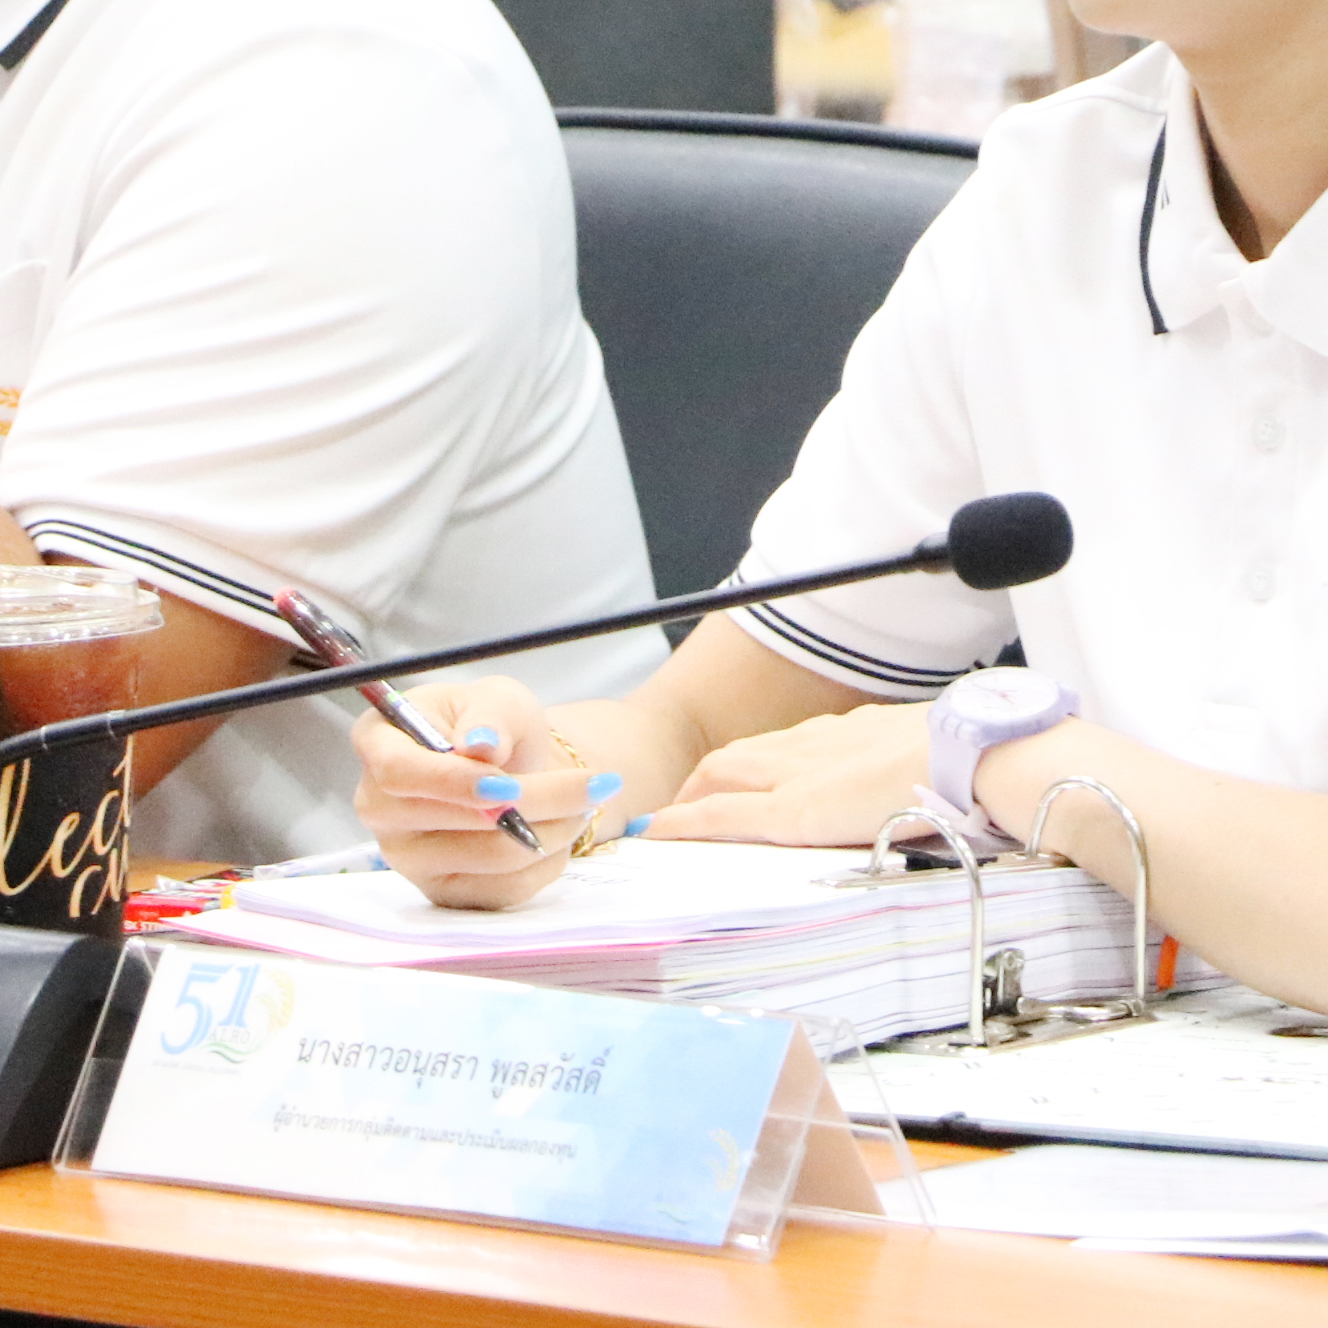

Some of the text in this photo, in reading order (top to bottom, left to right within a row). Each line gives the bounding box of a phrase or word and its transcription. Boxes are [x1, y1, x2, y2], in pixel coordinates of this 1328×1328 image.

[160, 962, 262, 1056] 51
[296, 1036, 615, 1100] นางสาวอนุสรา พูลสวัสดิ์
